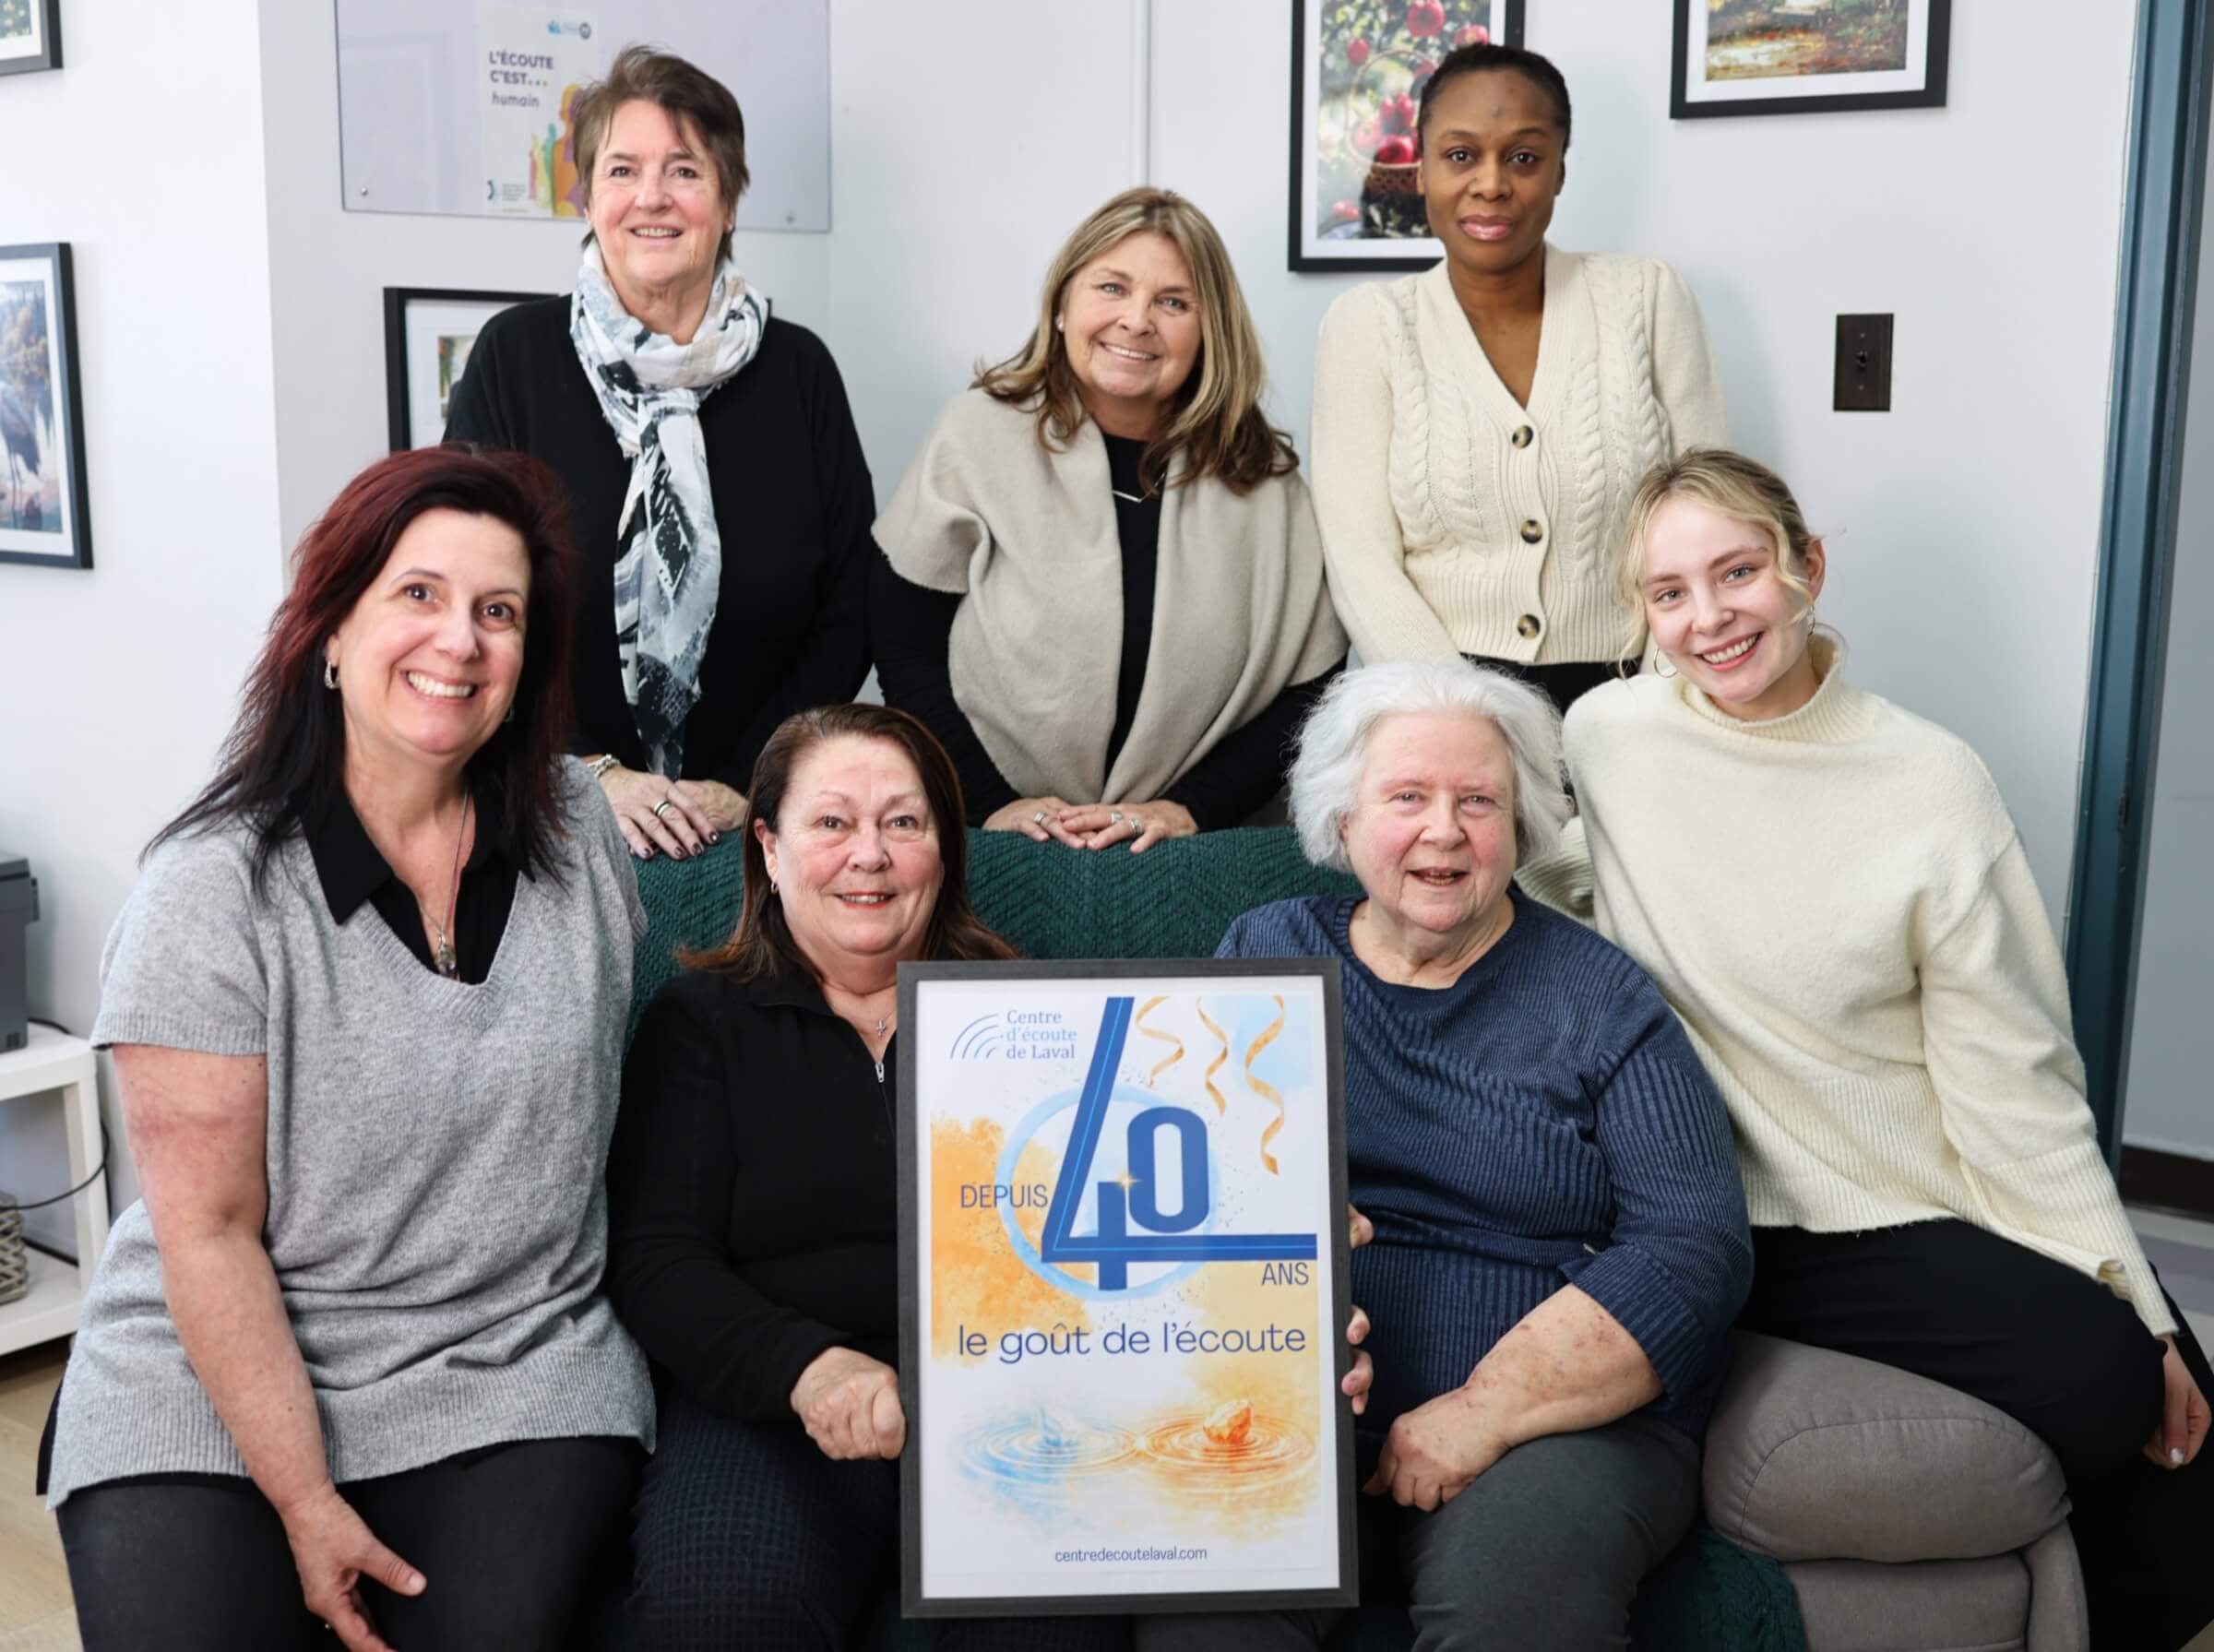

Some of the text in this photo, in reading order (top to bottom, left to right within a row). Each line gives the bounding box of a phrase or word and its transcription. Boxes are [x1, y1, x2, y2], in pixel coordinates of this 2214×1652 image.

[492, 91, 539, 107] humain
[1006, 1009, 1062, 1025] Centre
[1006, 1026, 1077, 1042] d'écoute
[1006, 1044, 1076, 1060] de Laval
[960, 996, 1317, 1290] DEPUIS 40
[1261, 1262, 1310, 1286] ANS
[958, 1325, 988, 1356] le
[999, 1322, 1090, 1364] goût
[1102, 1323, 1150, 1354] de
[1054, 1546, 1208, 1563] centredecoutelaval.com
